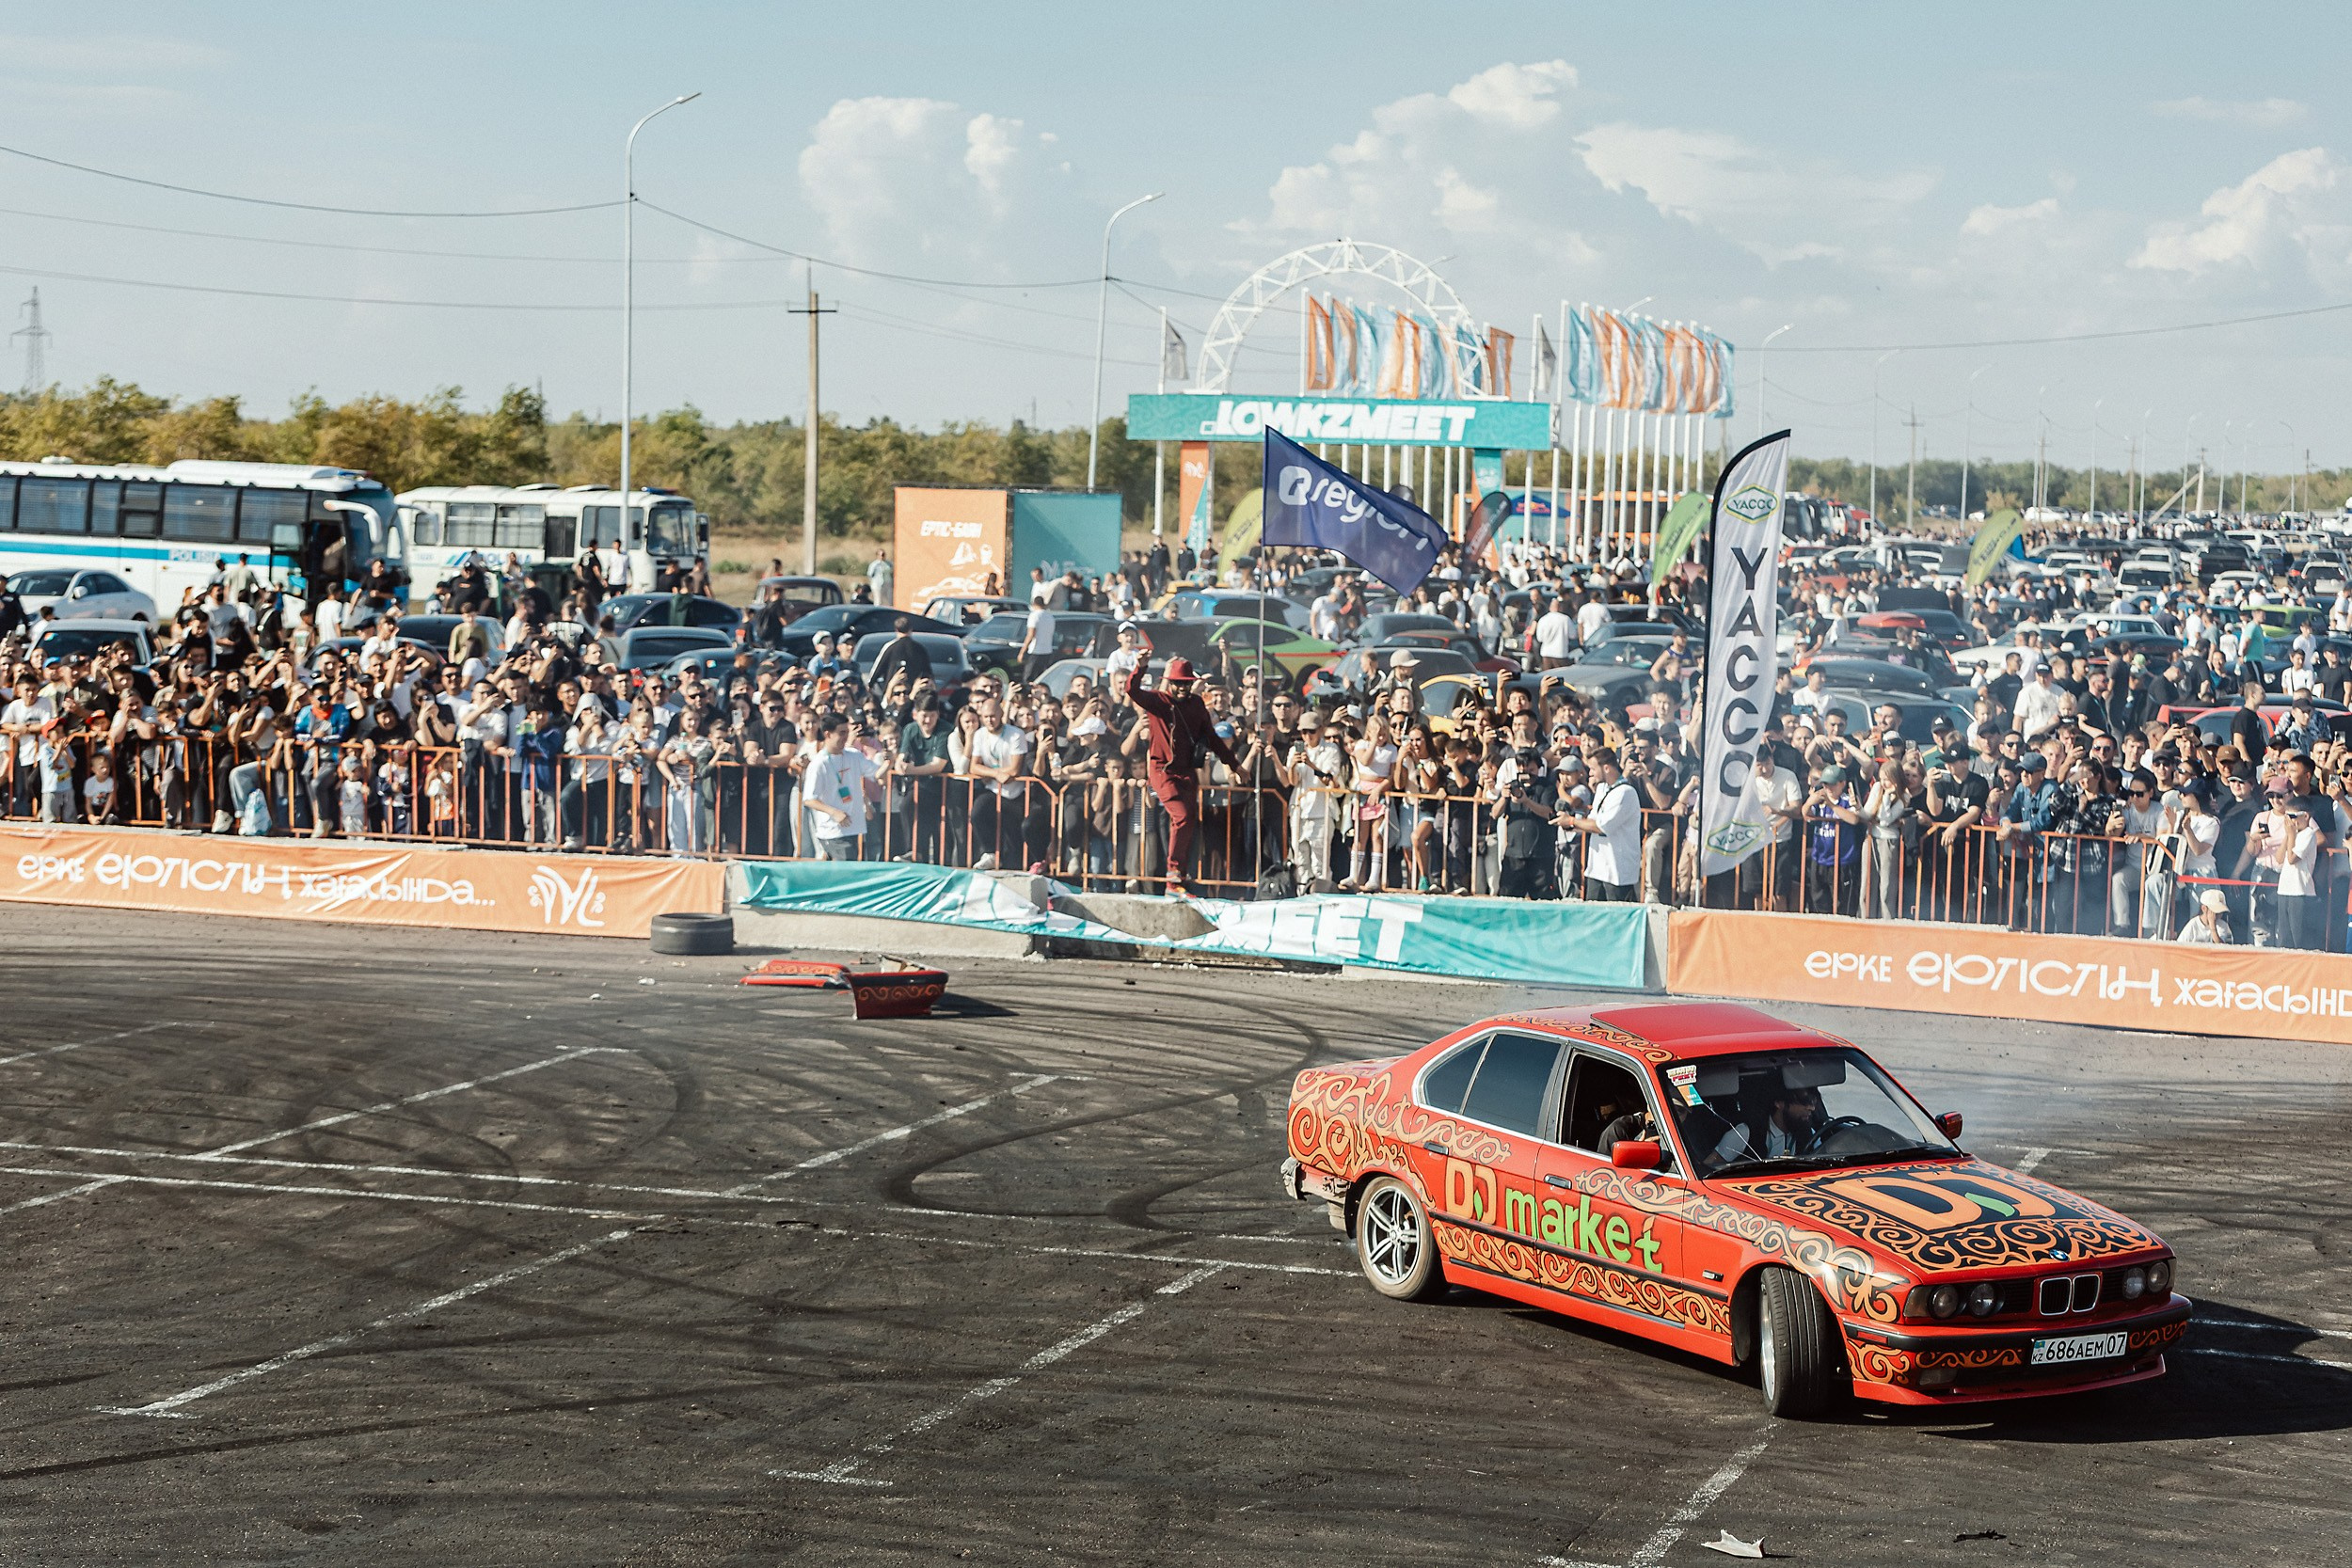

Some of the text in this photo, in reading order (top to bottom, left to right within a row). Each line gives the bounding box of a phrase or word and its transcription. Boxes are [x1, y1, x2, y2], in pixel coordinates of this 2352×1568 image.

[1720, 547, 1769, 798] YACCO
[1505, 1188, 1662, 1274] market
[2032, 1353, 2044, 1362] KZ
